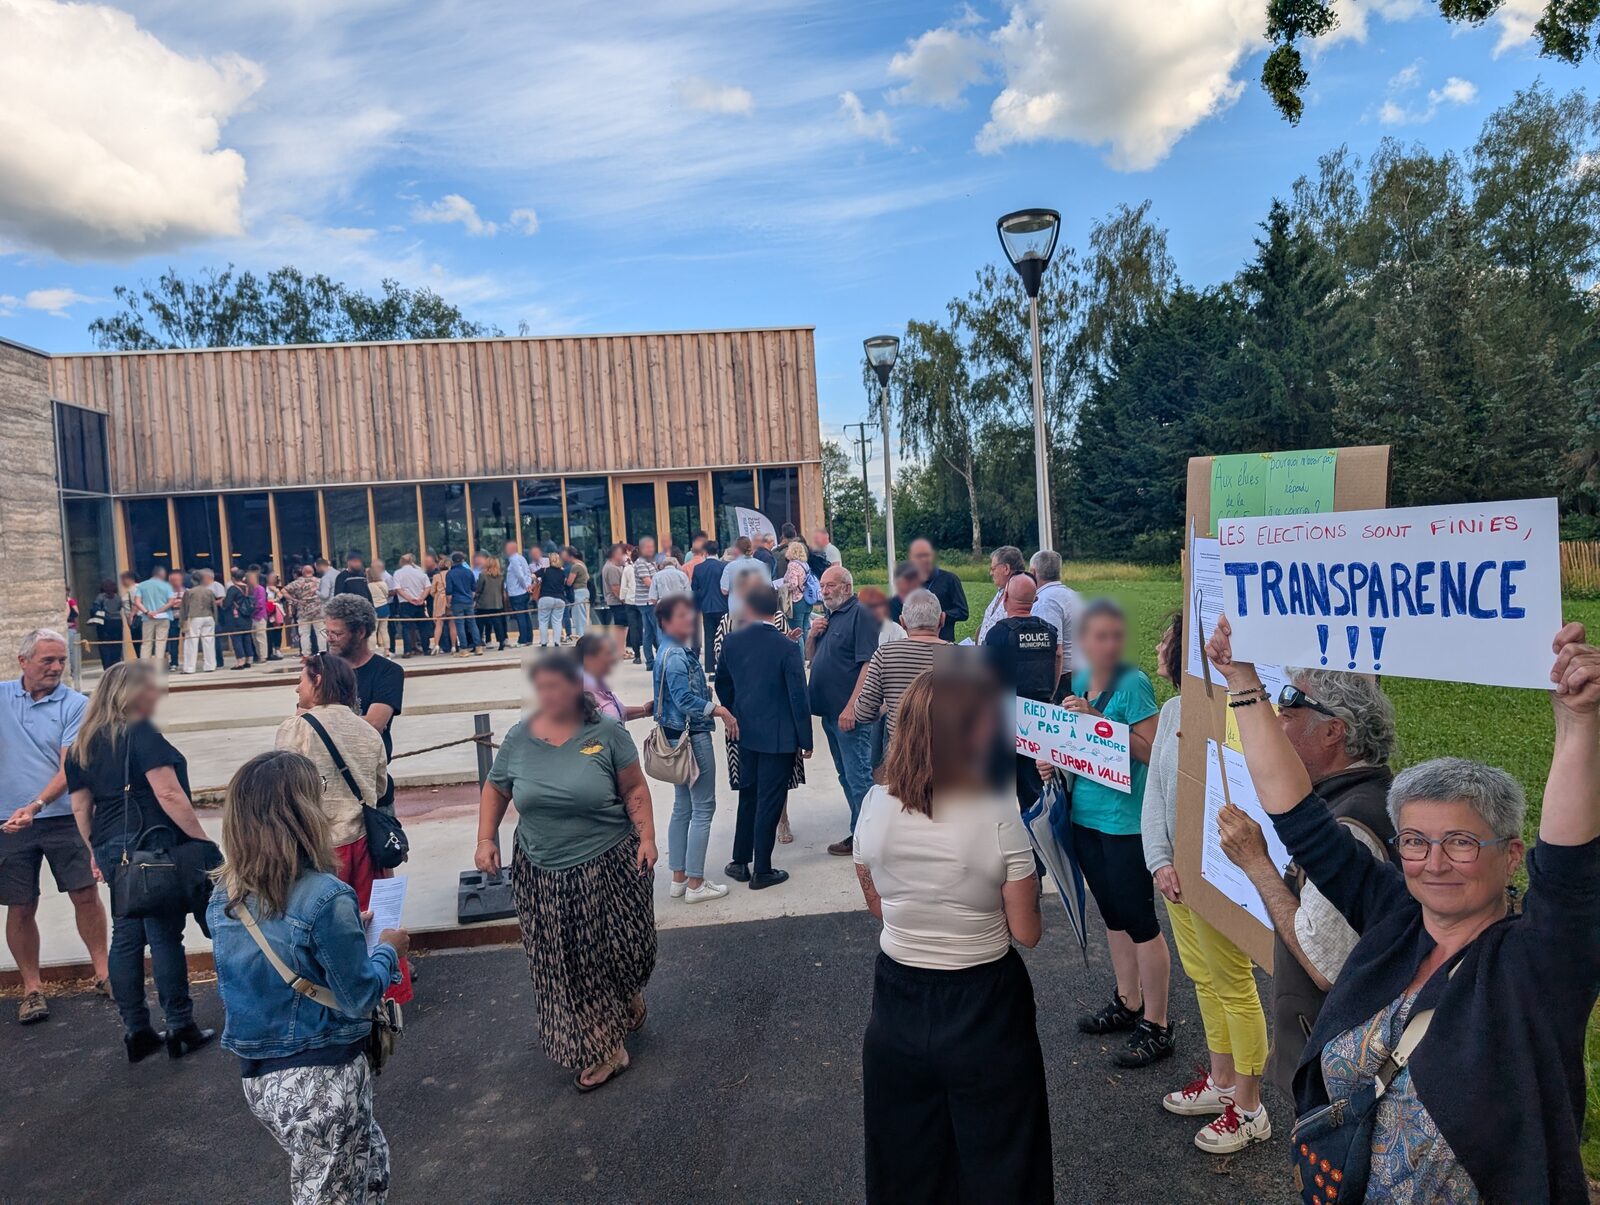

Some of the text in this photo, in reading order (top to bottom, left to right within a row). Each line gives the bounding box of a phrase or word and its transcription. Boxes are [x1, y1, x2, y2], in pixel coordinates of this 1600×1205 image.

[1213, 463, 1233, 491] Aux
[1219, 525, 1246, 546] LES
[1362, 524, 1412, 539] SONT
[1223, 560, 1527, 620] TRANSPARENCE
[1019, 632, 1050, 642] POLICE
[1019, 641, 1051, 649] MUNICIPALE
[1051, 707, 1079, 724] N'EST
[1037, 720, 1127, 753] PAS À VENDRE
[1016, 735, 1041, 754] STOP
[1051, 748, 1095, 775] EUROPA
